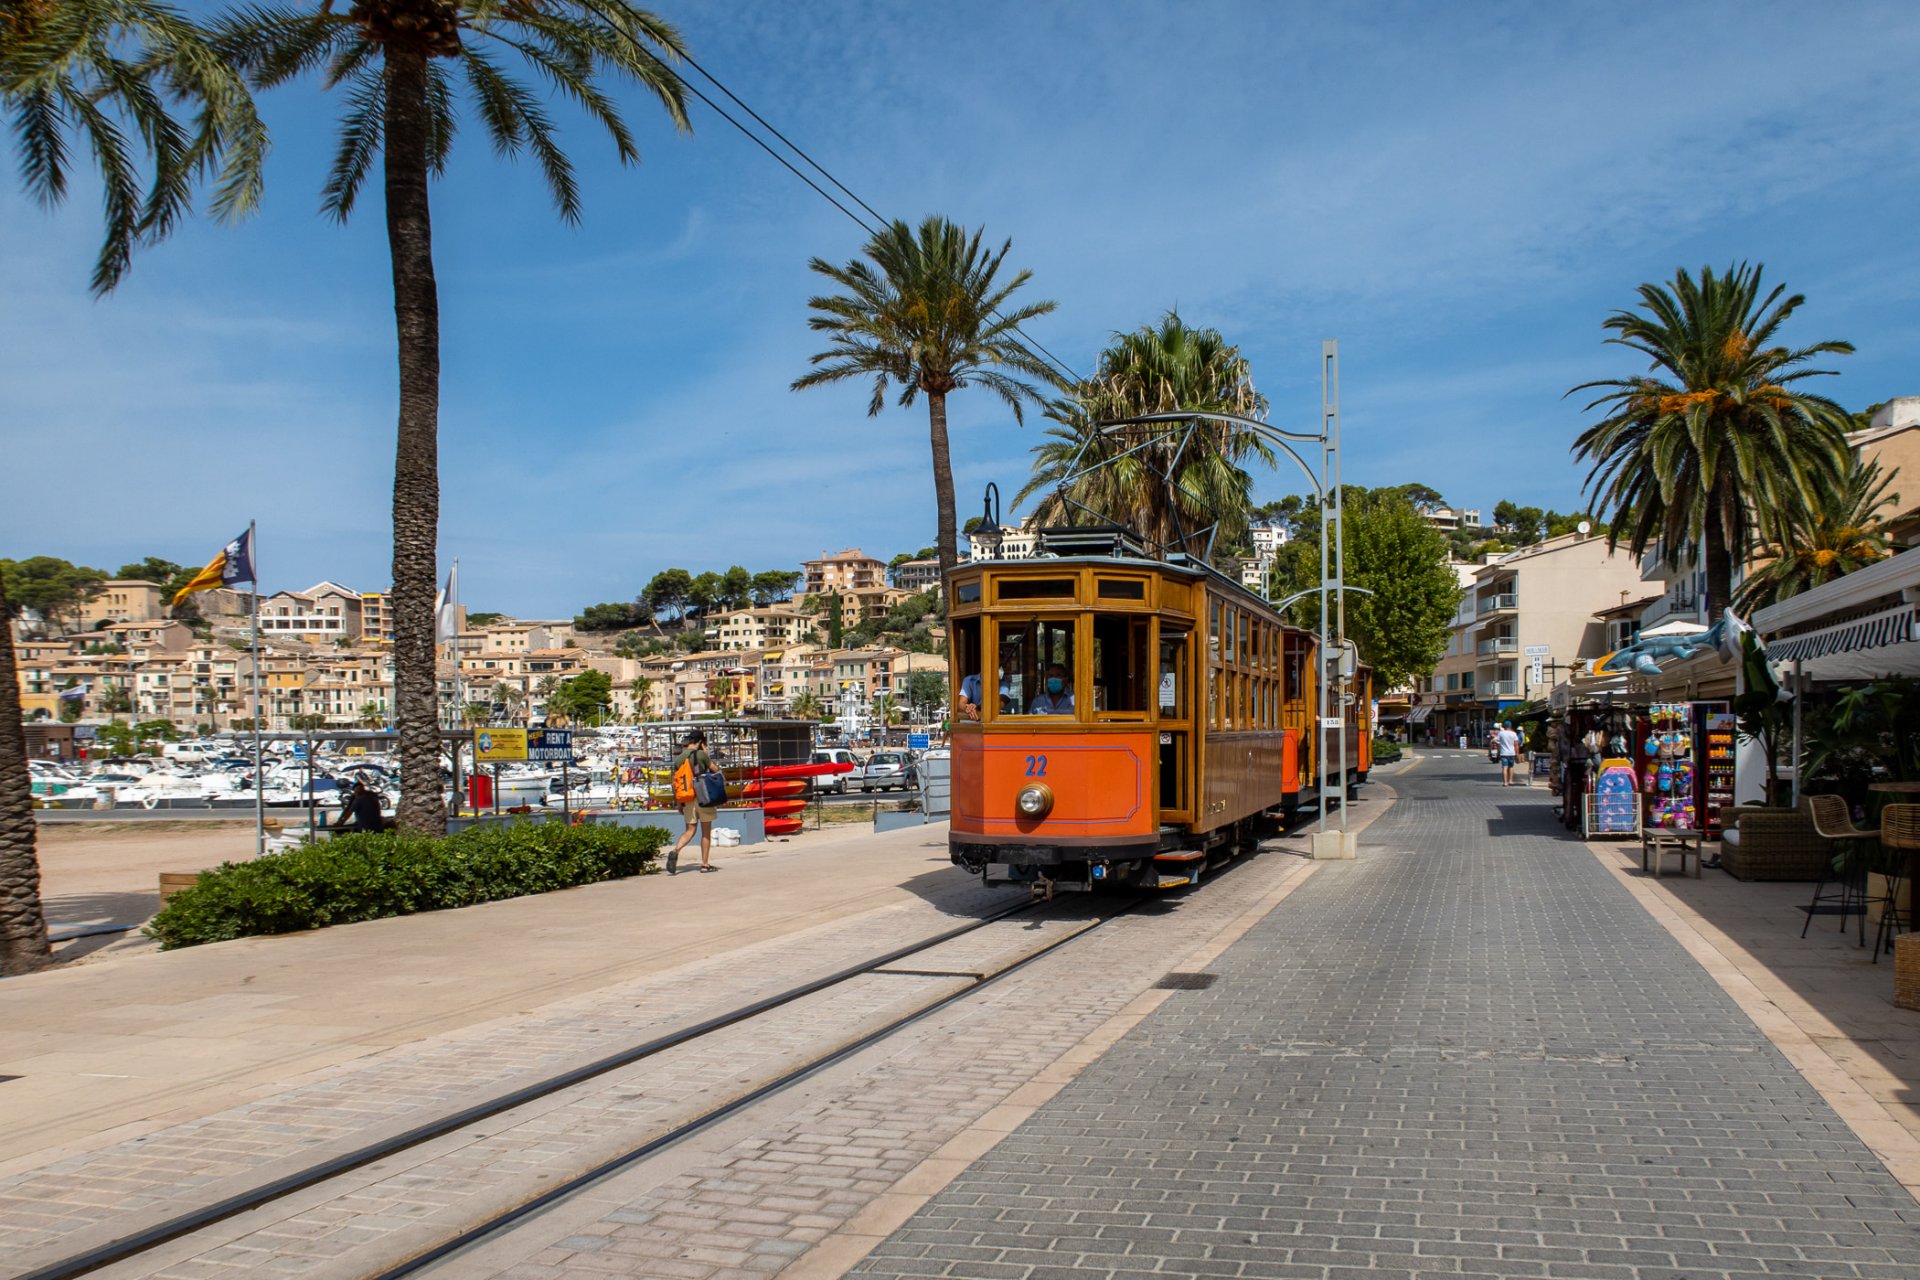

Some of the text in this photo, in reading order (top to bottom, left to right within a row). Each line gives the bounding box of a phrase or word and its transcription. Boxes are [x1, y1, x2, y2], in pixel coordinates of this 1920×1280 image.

[546, 733, 571, 744] RENT A
[528, 747, 571, 760] MOTORBOAT
[1025, 755, 1047, 777] 22
